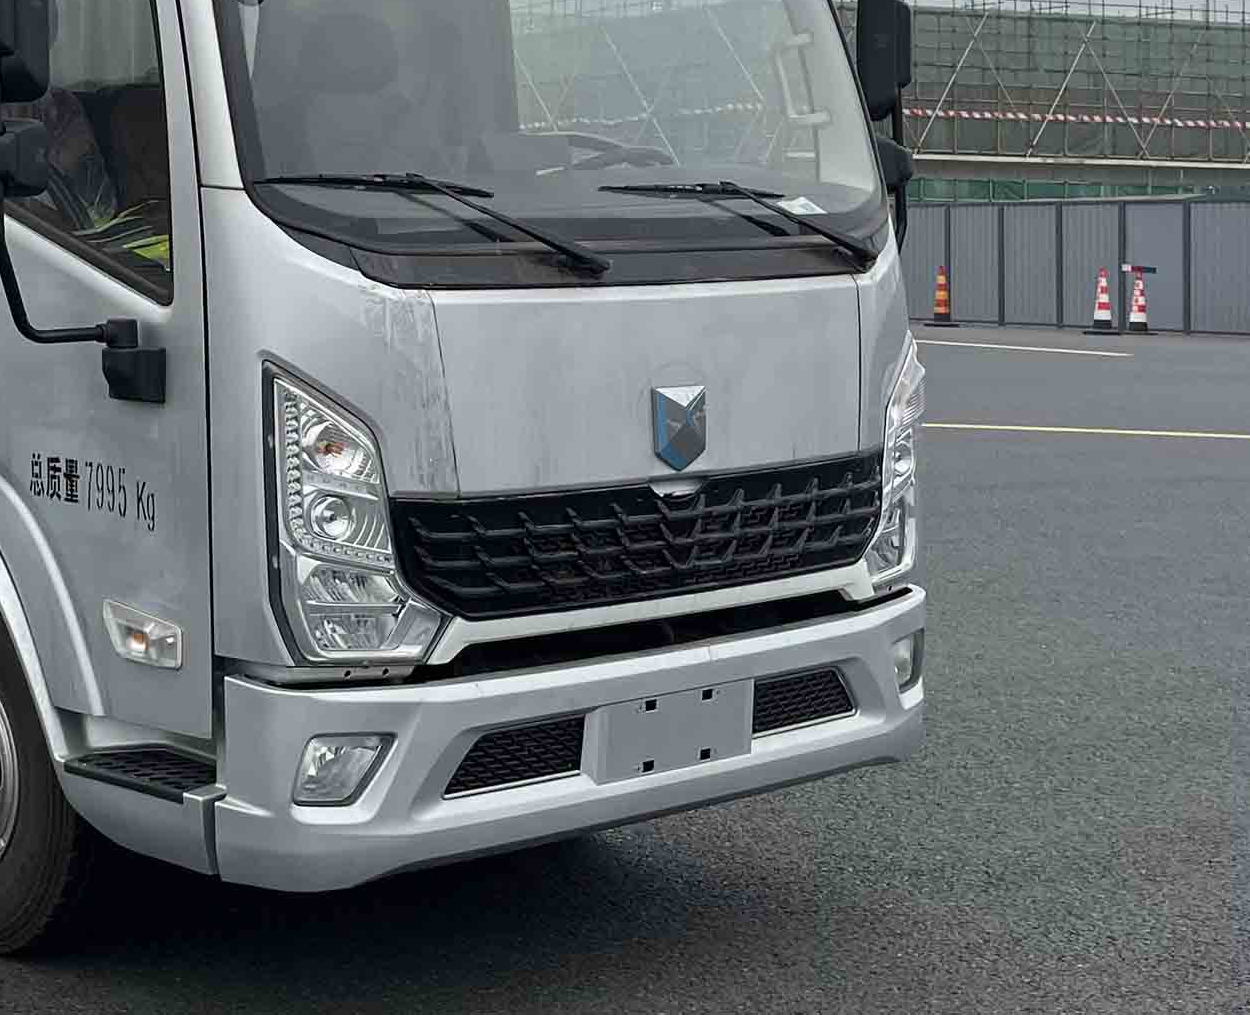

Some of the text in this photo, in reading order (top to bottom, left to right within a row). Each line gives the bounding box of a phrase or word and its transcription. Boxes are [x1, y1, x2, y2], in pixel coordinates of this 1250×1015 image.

[29, 452, 156, 532] 总质量 7995 Kg
